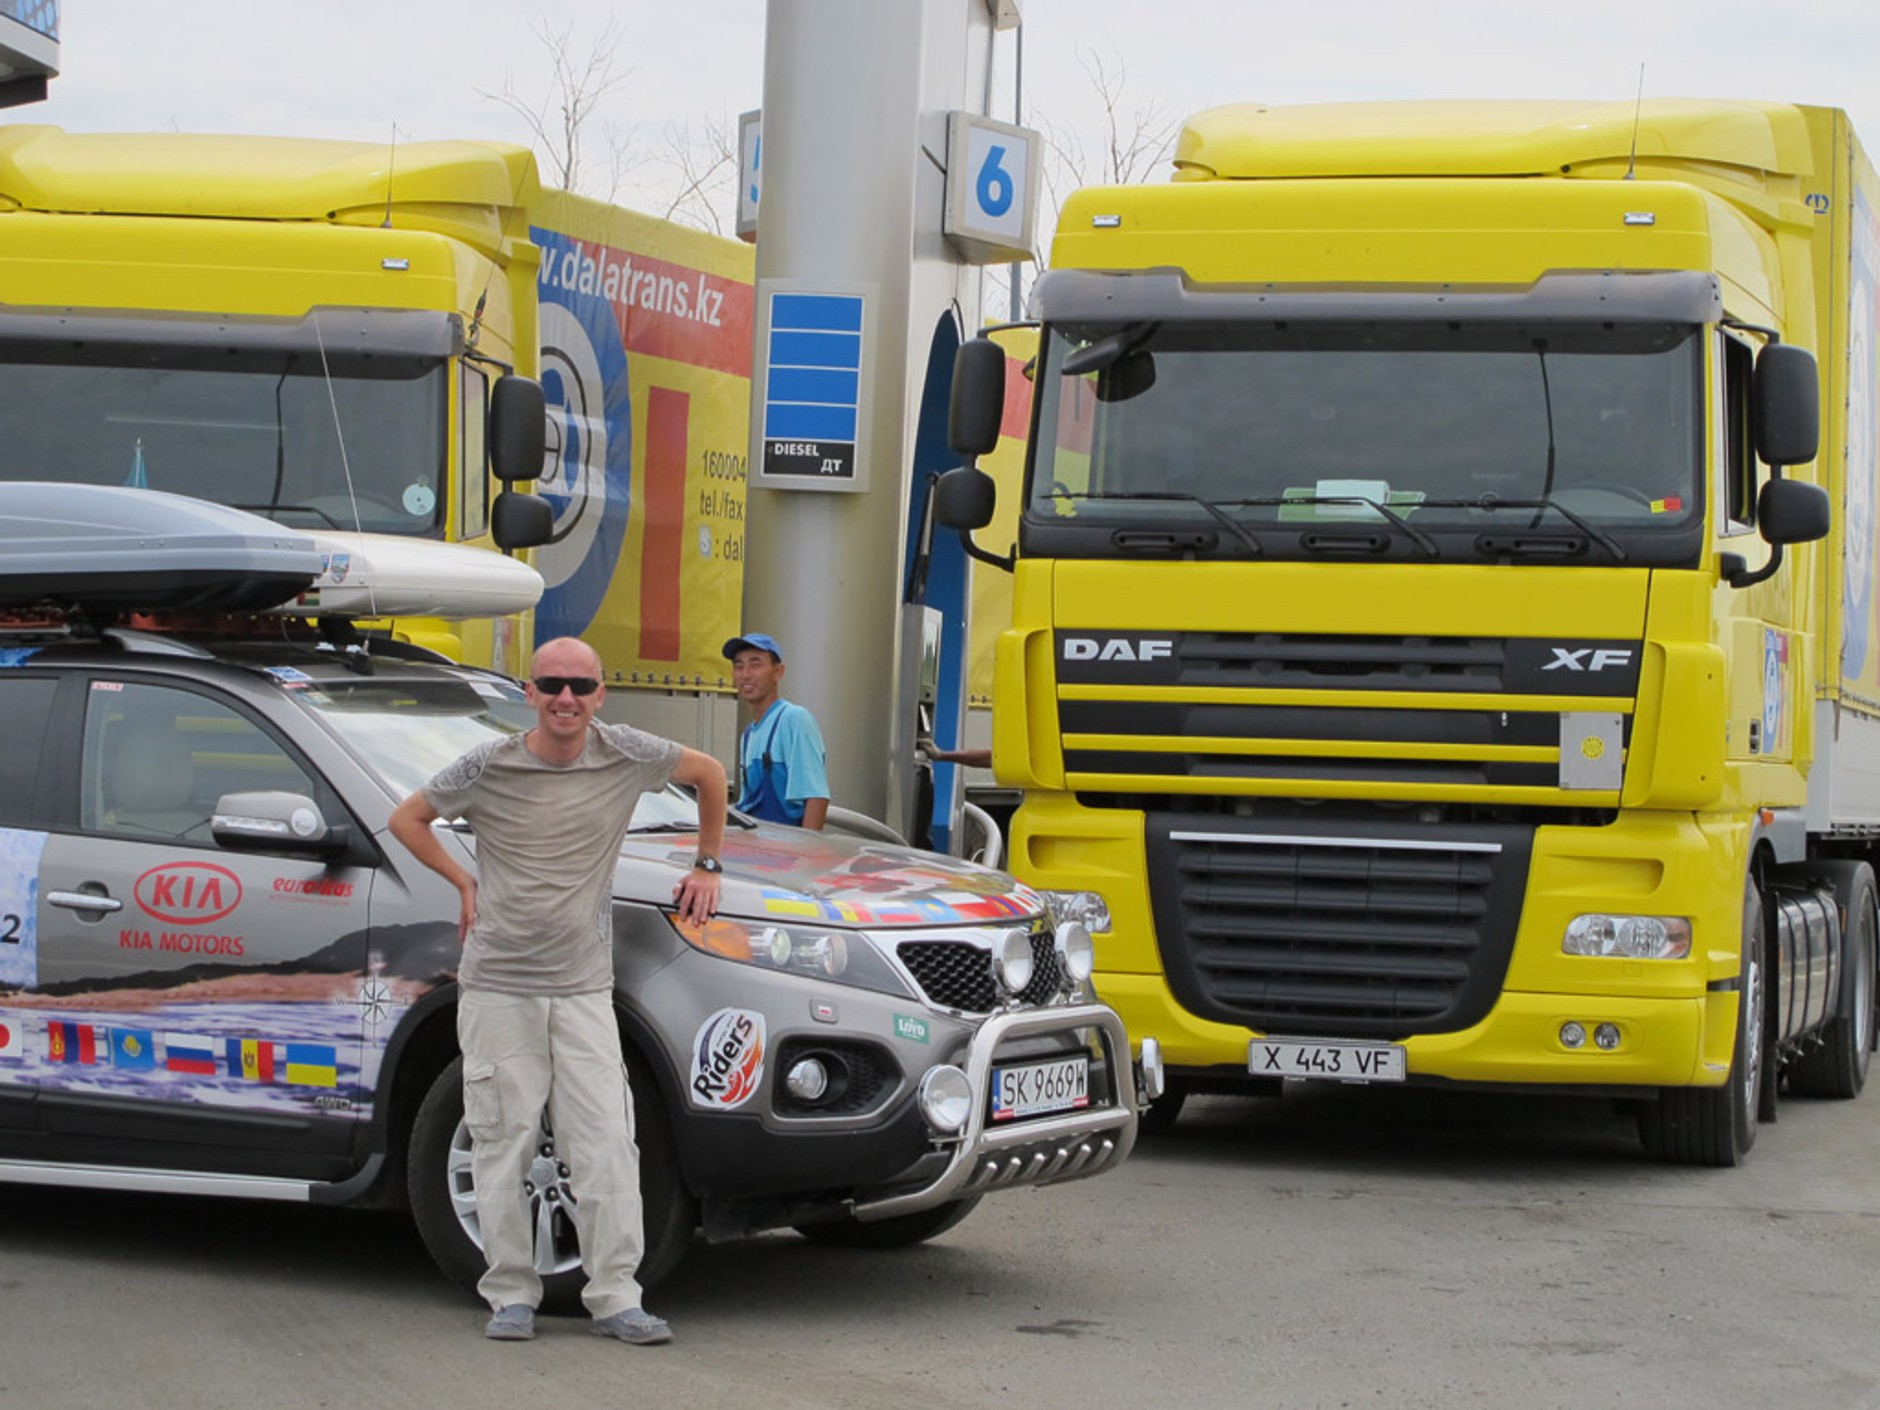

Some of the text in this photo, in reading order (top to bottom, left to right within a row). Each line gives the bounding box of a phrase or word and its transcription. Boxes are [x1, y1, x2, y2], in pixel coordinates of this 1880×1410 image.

[976, 144, 1014, 218] 6
[774, 443, 820, 457] DIESEL
[702, 449, 747, 483] 160004
[1063, 638, 1173, 661] DAF
[1541, 648, 1632, 671] XF
[152, 873, 224, 910] KIA
[1, 914, 21, 944] 2
[119, 929, 245, 956] KIA MOTORS
[693, 1014, 753, 1101] Riders
[1264, 1046, 1390, 1074] X 443 VF
[1004, 1063, 1085, 1106] SK 9669W
